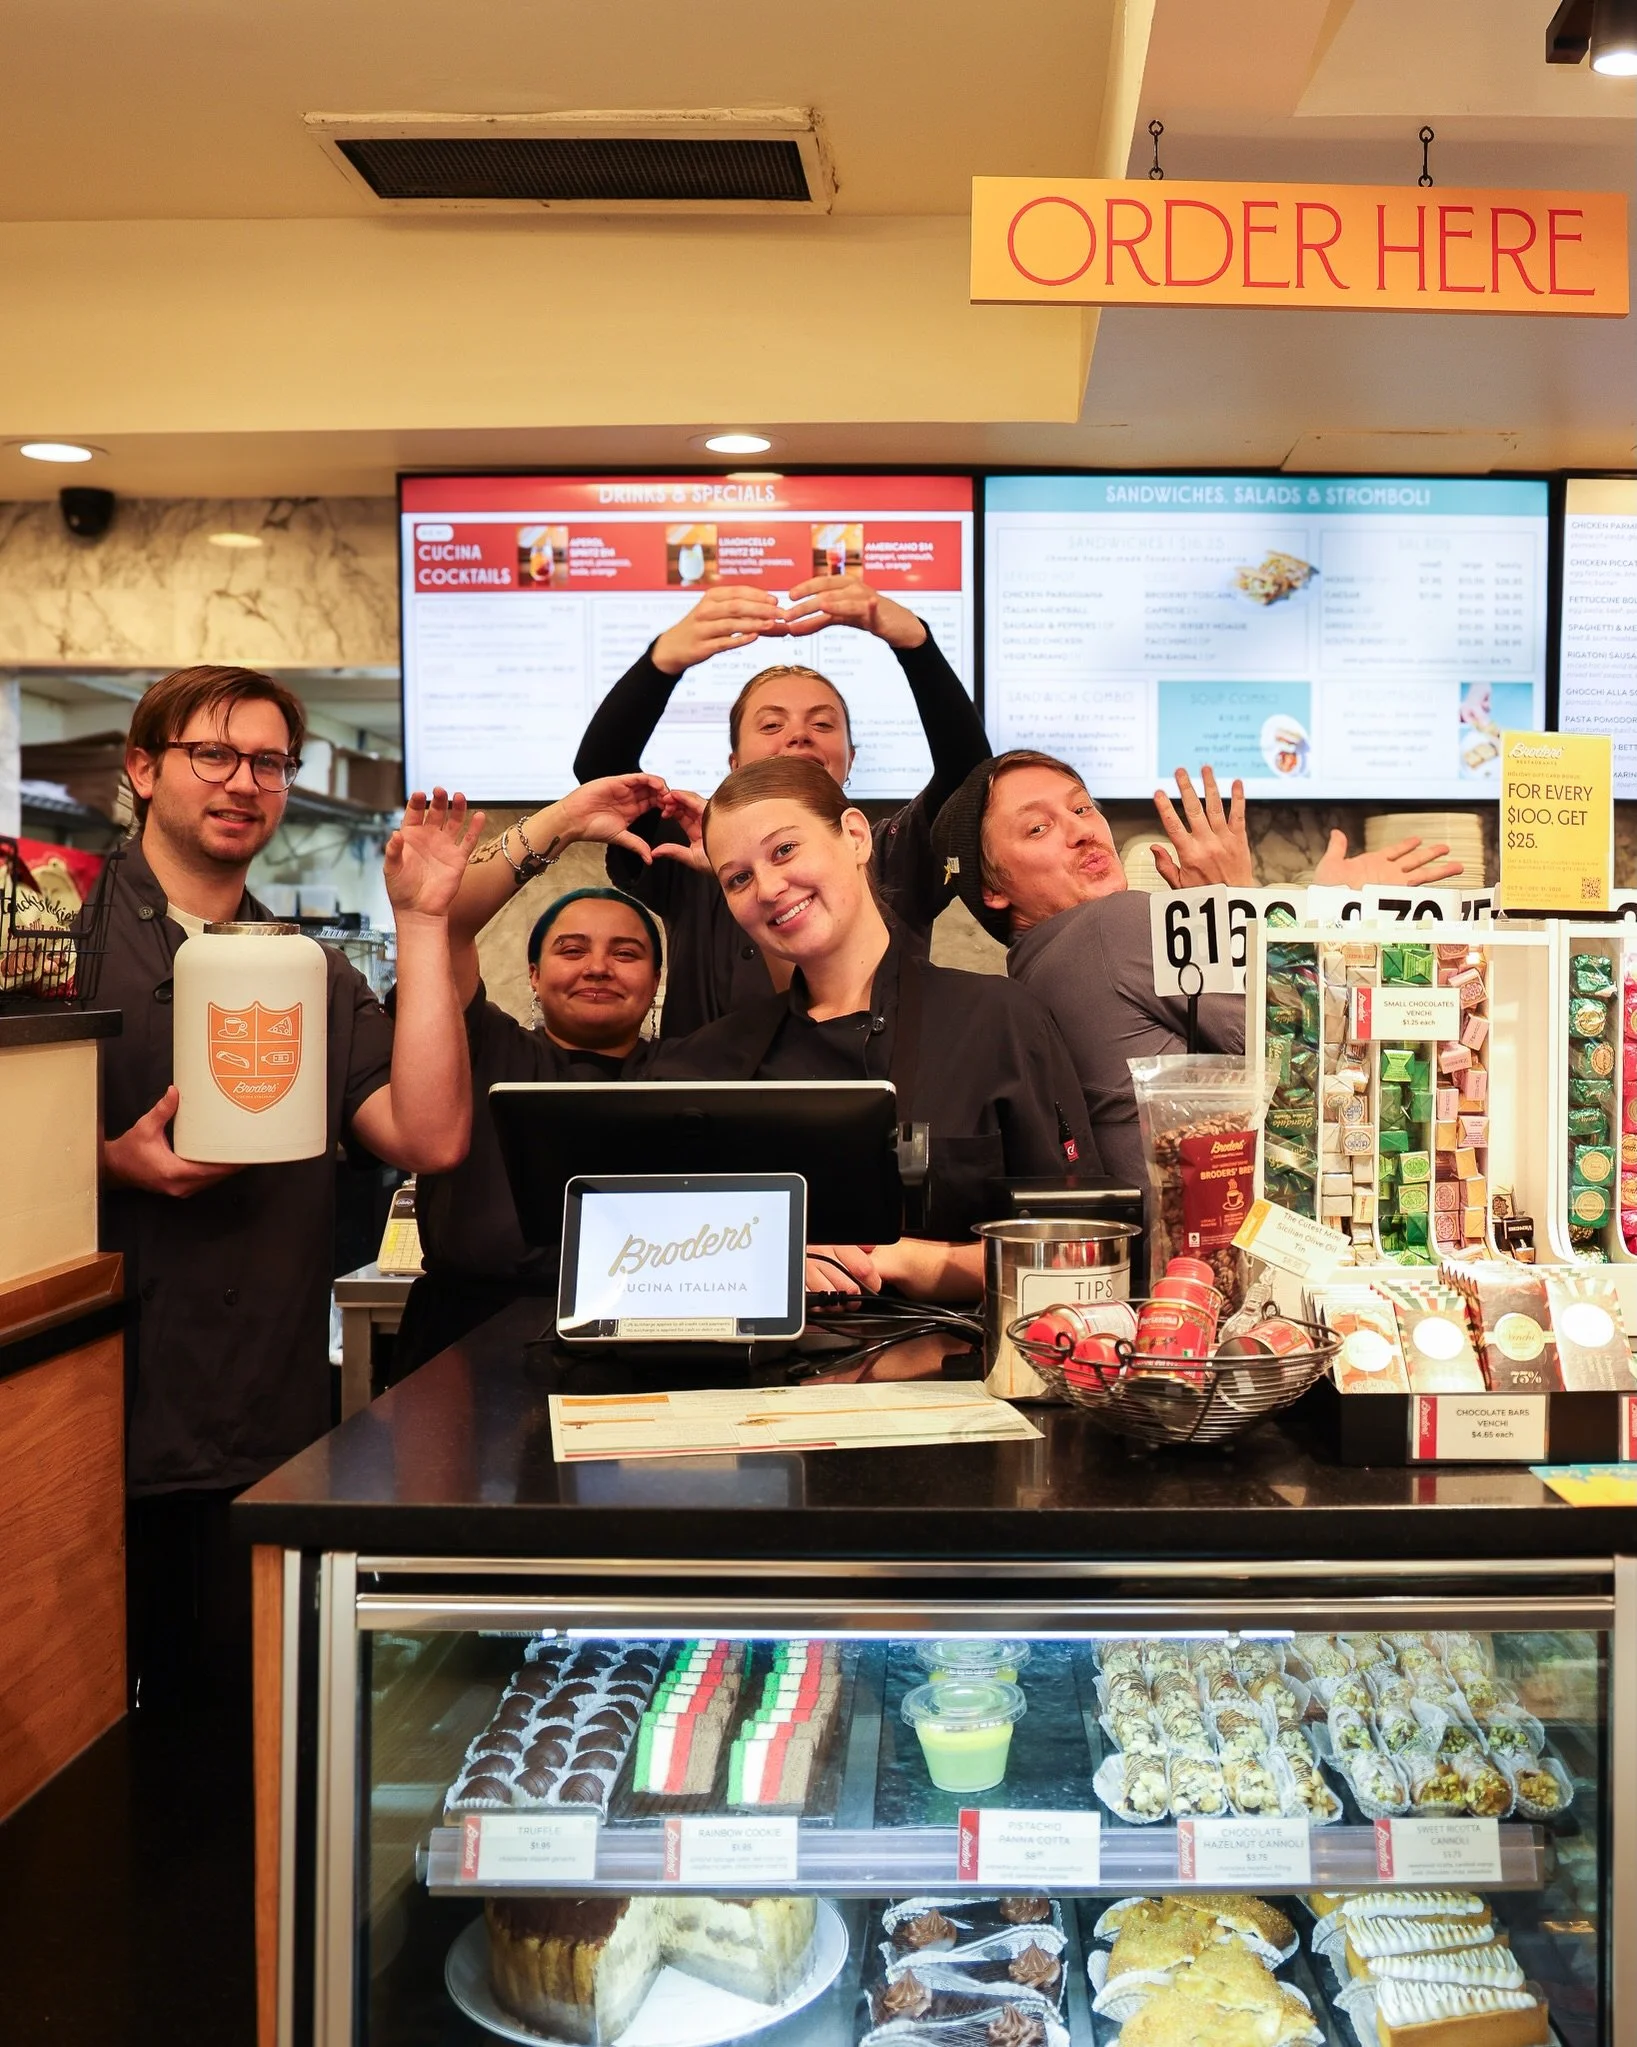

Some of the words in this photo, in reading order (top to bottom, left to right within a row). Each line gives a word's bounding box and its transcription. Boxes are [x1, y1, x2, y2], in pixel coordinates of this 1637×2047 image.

[1007, 196, 1350, 290] ORDER
[1376, 204, 1596, 296] HERE
[599, 486, 665, 504] DRINKS
[673, 486, 684, 503] &
[691, 484, 776, 503] SPECIALS
[1234, 485, 1302, 505] SALADS
[1307, 487, 1321, 505] &
[1326, 486, 1431, 506] STROMBOLI
[1571, 521, 1608, 530] CHICKEN
[719, 538, 776, 547] LIMONCELLO
[865, 542, 916, 551] AMERICANO
[418, 544, 482, 562] CUCINA
[1570, 559, 1607, 568] CHICKEN
[418, 567, 512, 585] COCKTAILS
[1569, 596, 1620, 604] FETTUCCINE
[1568, 624, 1614, 632] SPAGHETTI
[1567, 651, 1607, 660] RIGATONI
[1008, 690, 1078, 704] SANDWICH
[1082, 690, 1134, 704] COMBO
[1565, 688, 1605, 697] GNOCCHI
[1565, 716, 1592, 724] PASTA
[1508, 783, 1541, 800] FOR
[1545, 784, 1593, 802] EVERY
[1557, 809, 1588, 826] GET
[1507, 830, 1538, 849] $25.
[1164, 897, 1219, 968] 61
[1406, 1010, 1433, 1018] VENCHI
[233, 1081, 280, 1094] Broders'
[1200, 1168, 1238, 1180] BRODERS'
[1284, 1212, 1297, 1223] The
[1298, 1217, 1323, 1236] Cutest
[1324, 1230, 1342, 1242] Mini
[1276, 1222, 1304, 1240] Sicilian
[1305, 1234, 1325, 1248] Olive
[1325, 1243, 1338, 1253] Oil
[608, 1216, 760, 1278] Broders'
[1294, 1242, 1306, 1253] Tin
[623, 1282, 673, 1293] UCINA
[680, 1281, 748, 1293] ITALIANA
[1074, 1279, 1113, 1301] TIPS
[1456, 1409, 1505, 1417] CHOCOLATE
[1508, 1409, 1530, 1417] BARS
[1476, 1420, 1509, 1428] VENCHI
[518, 1826, 561, 1836] TRUFFLE
[698, 1828, 743, 1838] RAINBOW
[745, 1827, 781, 1838] COOKIE
[1008, 1822, 1062, 1832] PISTACHIO
[1417, 1825, 1444, 1834] SWEET
[1221, 1828, 1282, 1838] CHOCOLATE
[999, 1835, 1036, 1845] PANNA
[1037, 1836, 1071, 1846] COTTA
[1203, 1840, 1256, 1849] HAZELNUT
[1258, 1840, 1304, 1849] CANNOLI
[1430, 1837, 1470, 1846] CANNOLI
